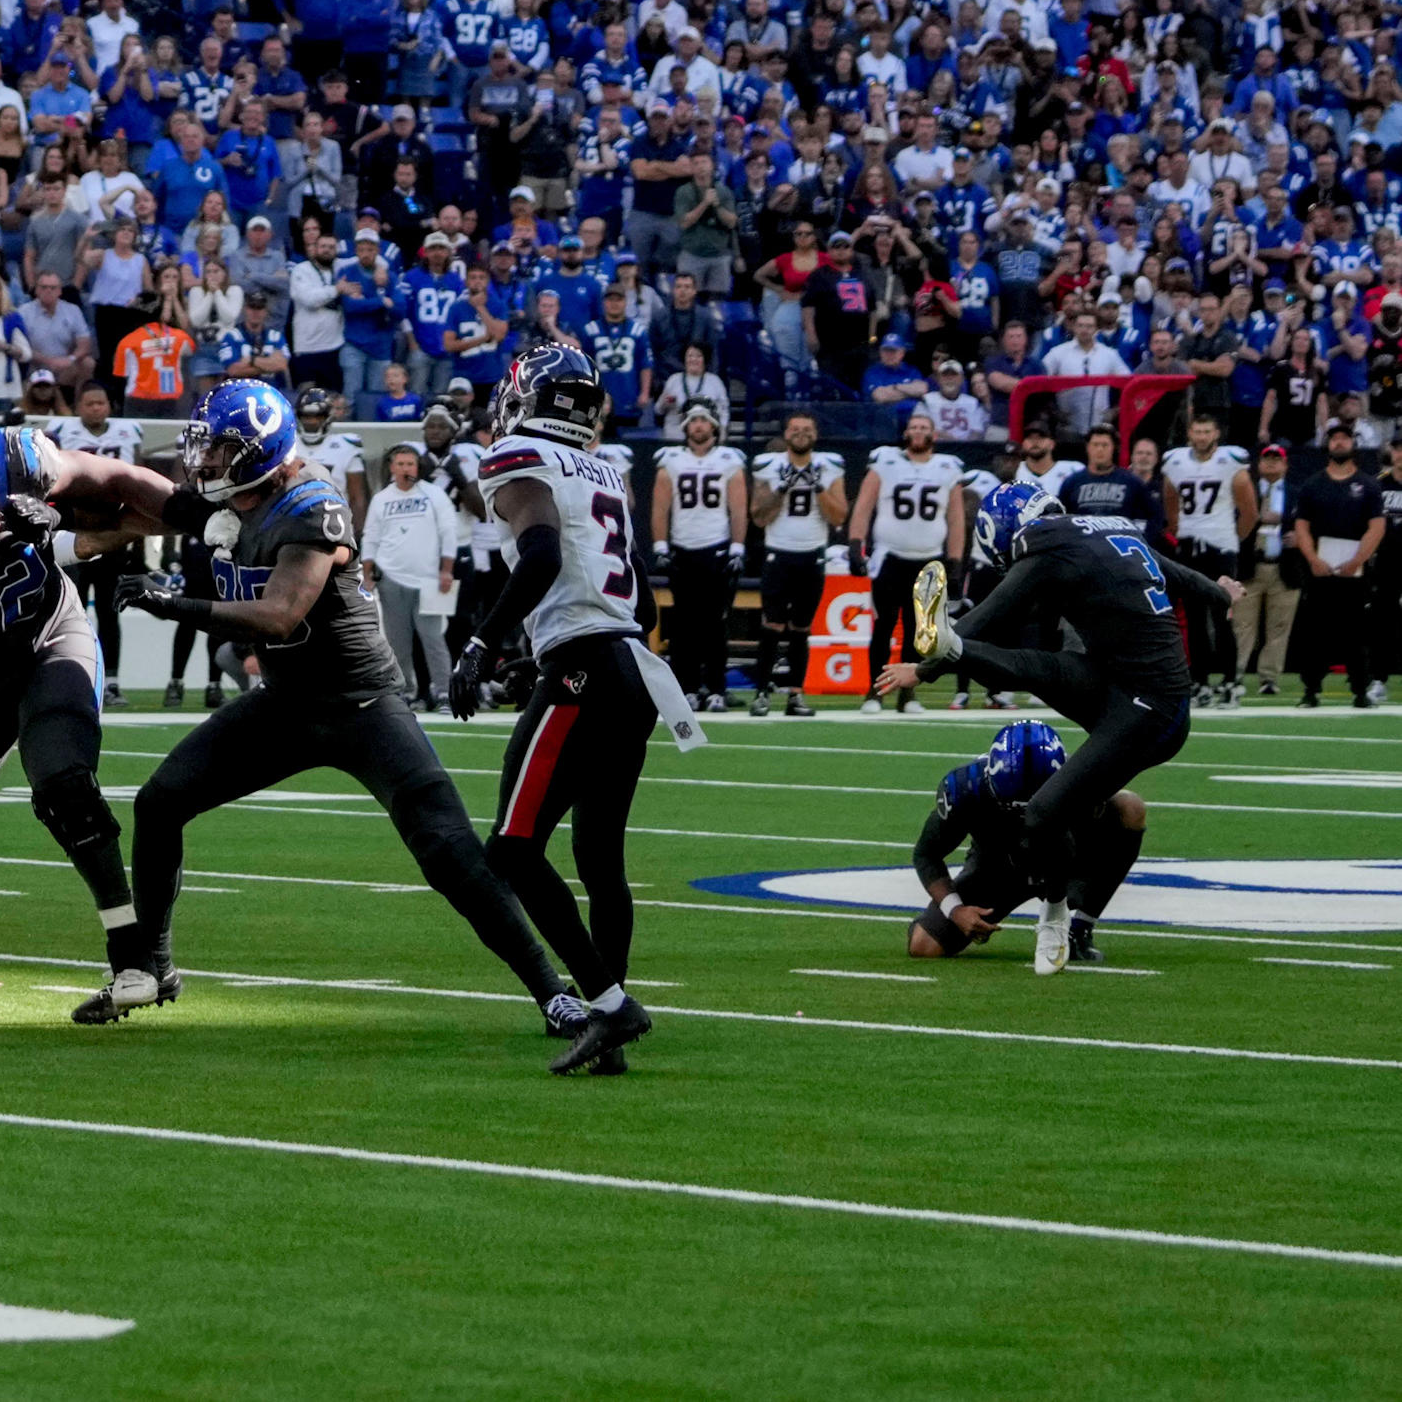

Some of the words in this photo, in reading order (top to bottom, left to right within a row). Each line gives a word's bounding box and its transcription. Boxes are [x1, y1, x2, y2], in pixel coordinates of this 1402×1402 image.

[456, 11, 493, 45] 97
[510, 28, 538, 53] 28
[417, 287, 456, 323] 87
[1290, 377, 1315, 404] 51
[542, 421, 593, 442] HOUSTON
[676, 473, 723, 510] 86
[892, 483, 941, 522] 66
[382, 498, 429, 520] TEXANS
[1105, 534, 1173, 615] 3
[825, 652, 853, 683] G
